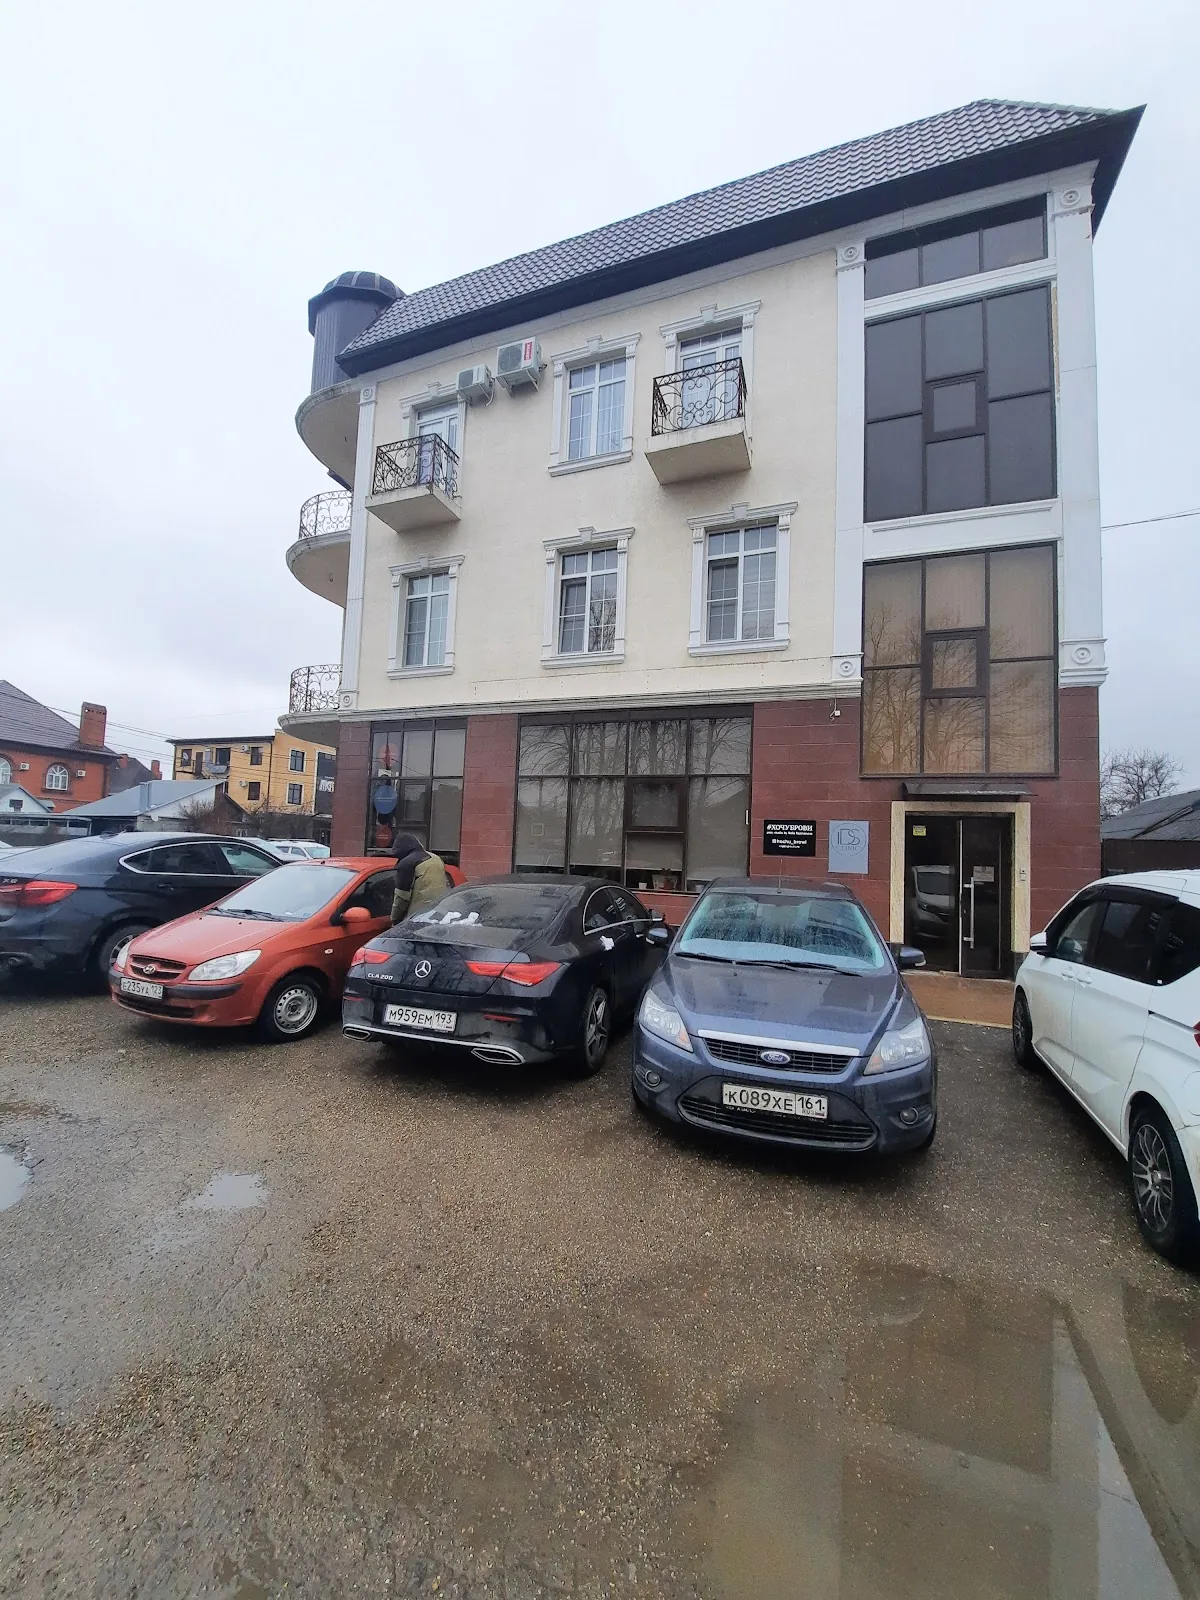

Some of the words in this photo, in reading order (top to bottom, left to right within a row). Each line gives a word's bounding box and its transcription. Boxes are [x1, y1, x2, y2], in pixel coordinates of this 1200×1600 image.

[766, 824, 813, 832] #ХОЧУБРОВИ
[388, 1008, 433, 1026] М959ЕМ
[435, 1012, 453, 1024] 193
[728, 1089, 794, 1112] К089ХЕ
[797, 1096, 822, 1111] 161
